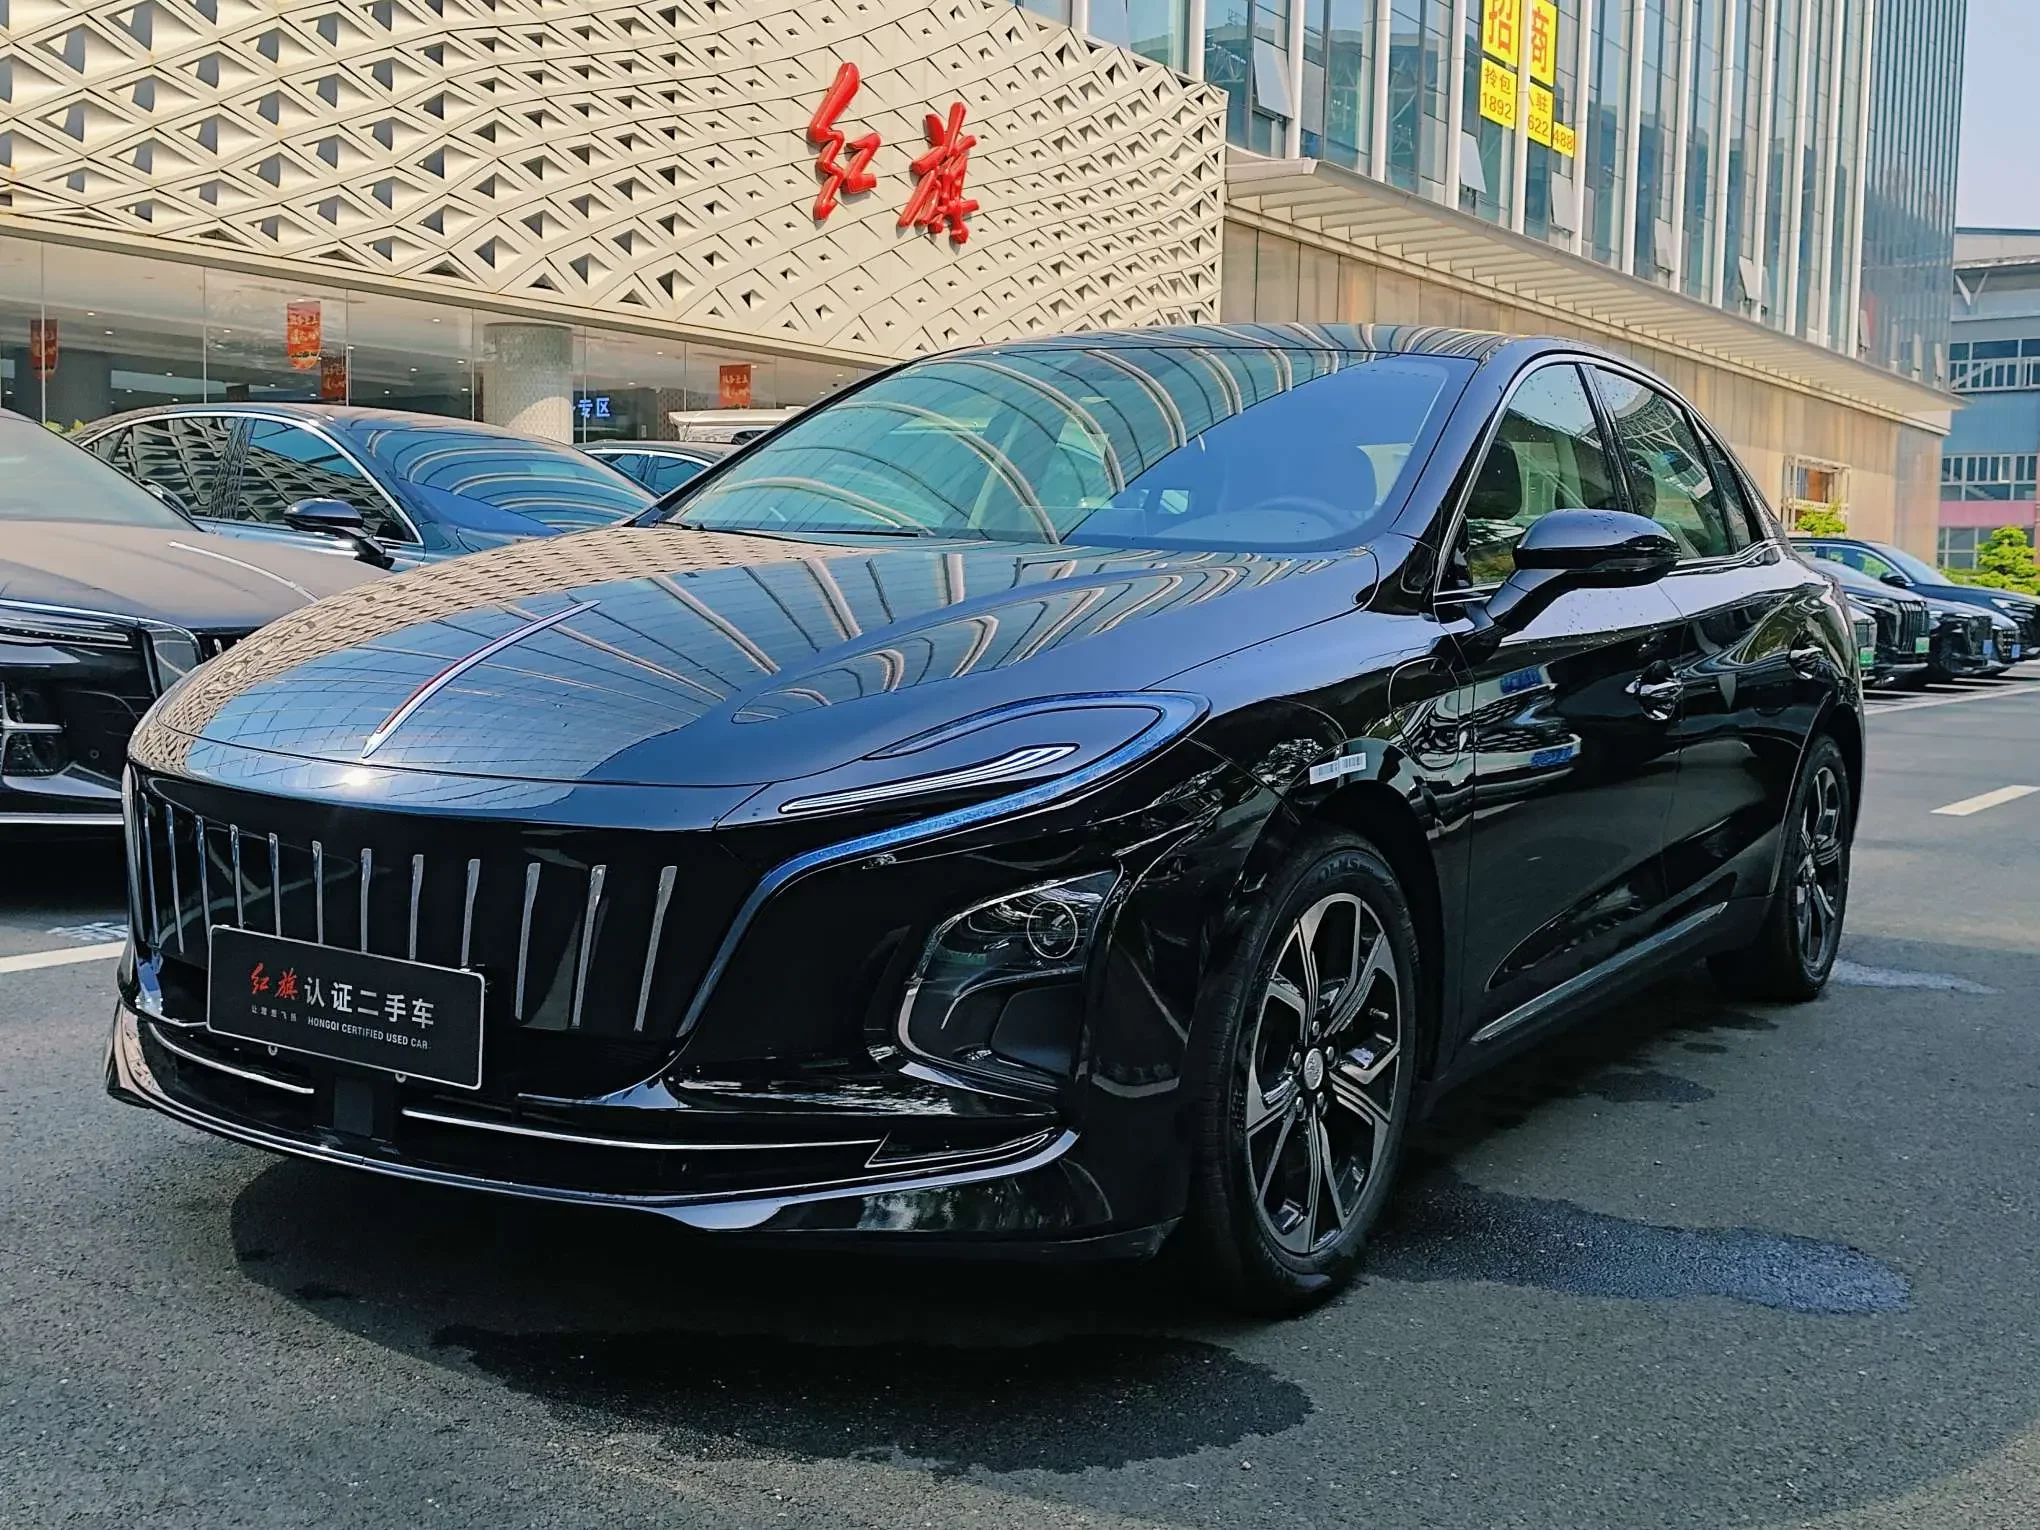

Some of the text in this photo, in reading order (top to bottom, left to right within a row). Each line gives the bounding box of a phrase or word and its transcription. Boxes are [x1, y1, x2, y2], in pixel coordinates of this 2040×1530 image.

[807, 62, 980, 245] 红旗
[573, 397, 610, 418] 专区
[307, 1016, 429, 1050] HONGQI CERTIFIED USED CAR
